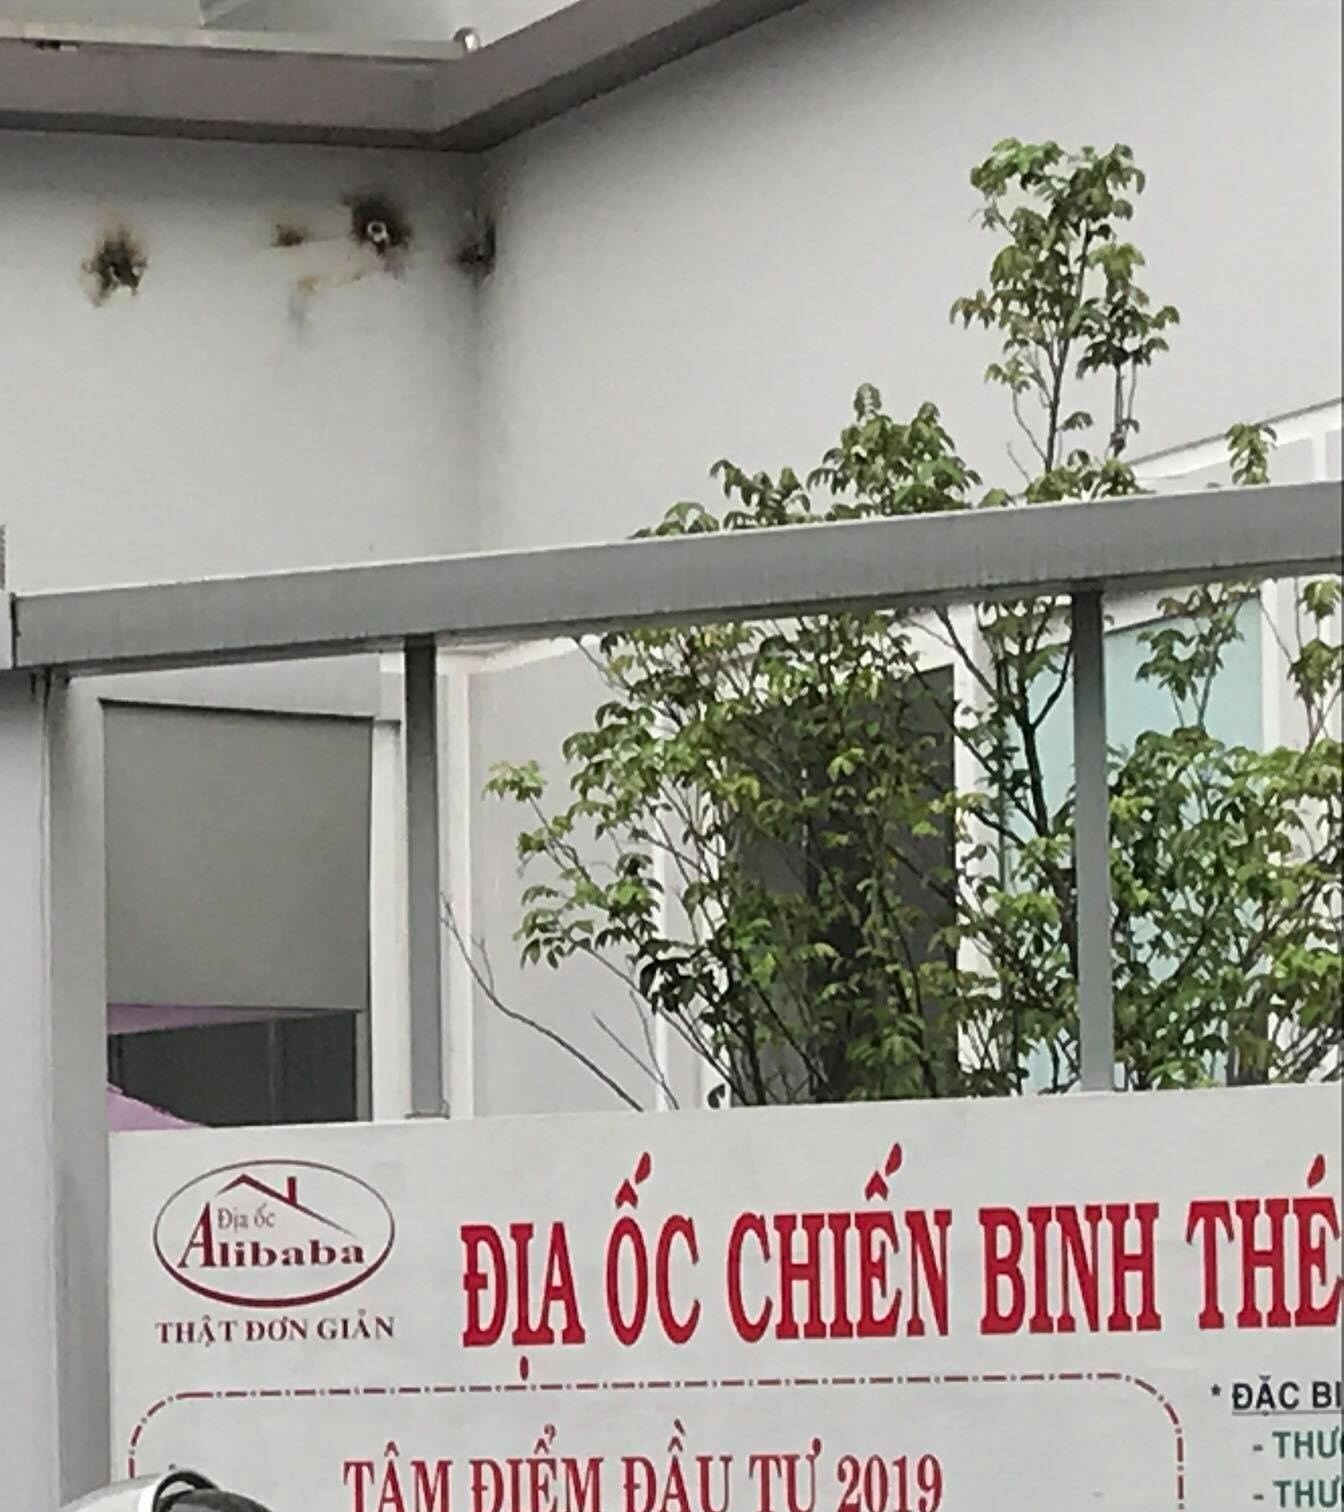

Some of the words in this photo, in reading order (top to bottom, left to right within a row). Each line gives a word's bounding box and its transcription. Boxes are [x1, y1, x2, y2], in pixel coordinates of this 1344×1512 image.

[177, 1202, 364, 1268] Alibaba
[217, 1206, 248, 1233] Địa
[254, 1202, 275, 1229] ốc
[460, 1221, 585, 1381] ĐỊA
[606, 1151, 701, 1347] ỐC
[727, 1142, 952, 1342] CHIẾN
[979, 1202, 1162, 1335] BINH
[156, 1314, 238, 1347] THẬT
[246, 1316, 308, 1340] ĐƠN
[317, 1309, 394, 1340] GIẢN
[1232, 1375, 1300, 1416] ĐẶC
[1272, 1426, 1344, 1459] THƯ
[1272, 1475, 1344, 1508] THƯ
